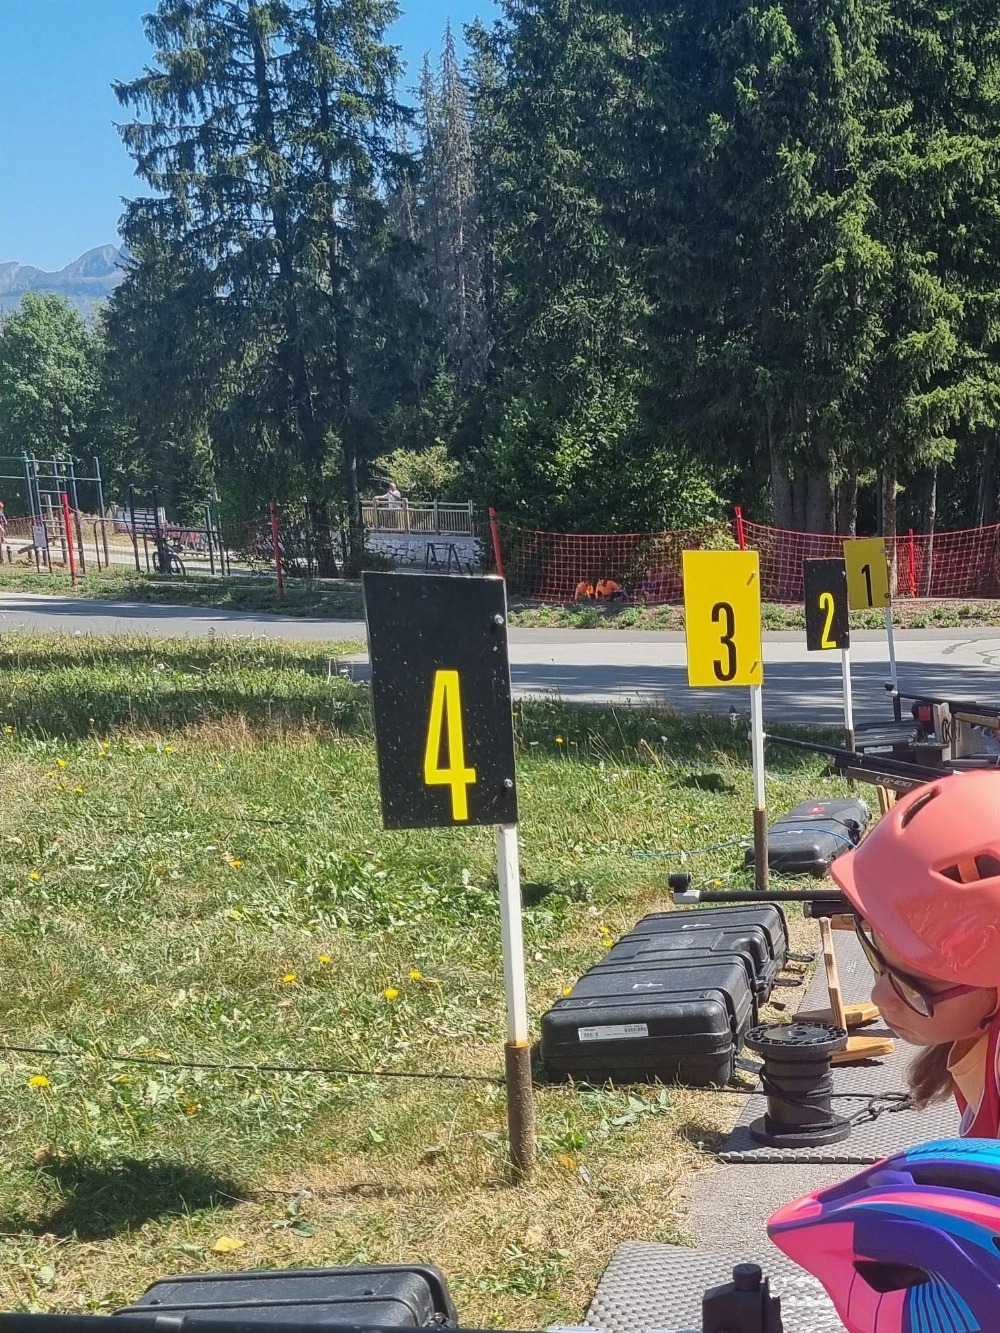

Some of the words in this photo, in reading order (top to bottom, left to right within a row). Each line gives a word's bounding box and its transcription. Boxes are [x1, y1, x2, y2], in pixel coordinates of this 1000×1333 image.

[861, 564, 873, 607] 1
[711, 601, 737, 682] 3
[820, 592, 836, 649] 2
[424, 670, 477, 820] 4
[876, 775, 912, 788] LG400
